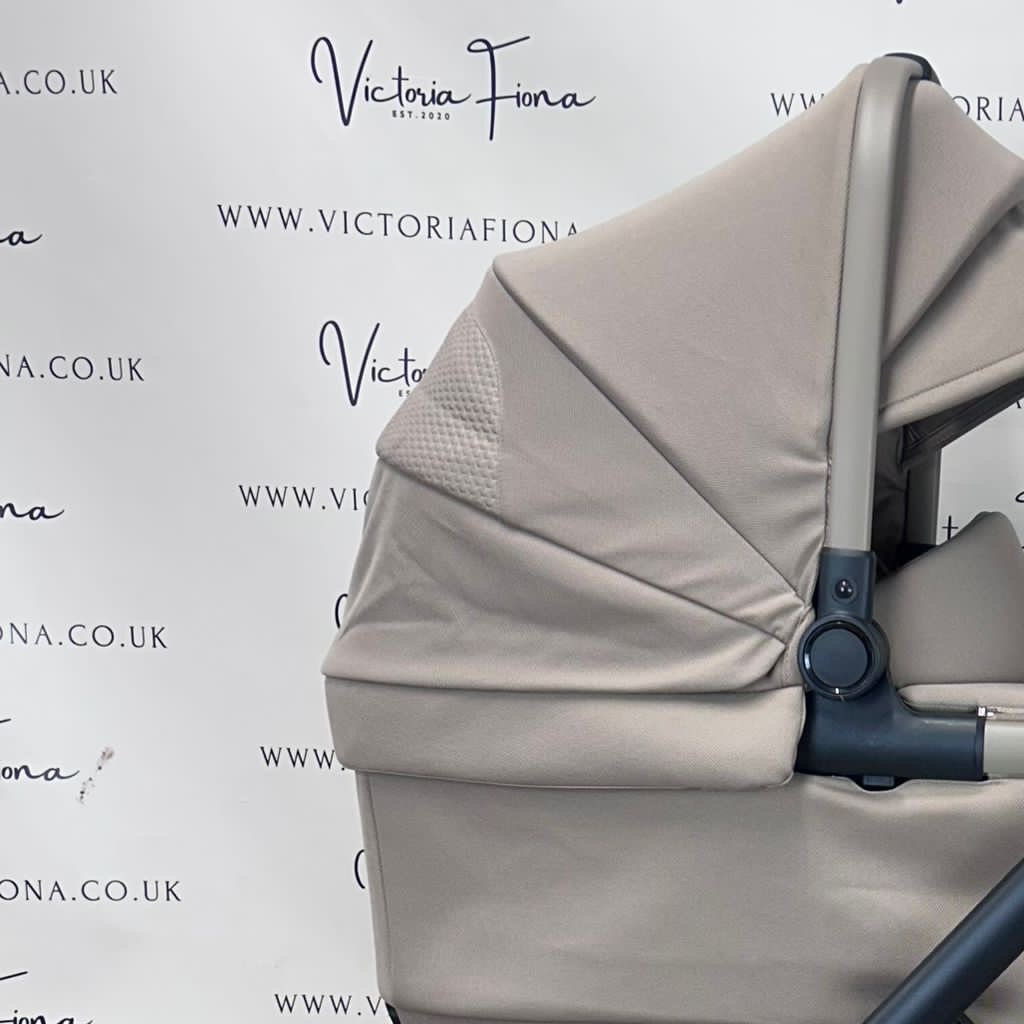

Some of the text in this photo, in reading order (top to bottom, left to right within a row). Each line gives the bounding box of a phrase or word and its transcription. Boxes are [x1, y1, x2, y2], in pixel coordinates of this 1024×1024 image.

[311, 36, 596, 141] Victoria Fiona
[392, 110, 450, 120] EST.2020
[319, 320, 426, 407] Victo
[240, 485, 370, 510] WWW.VI
